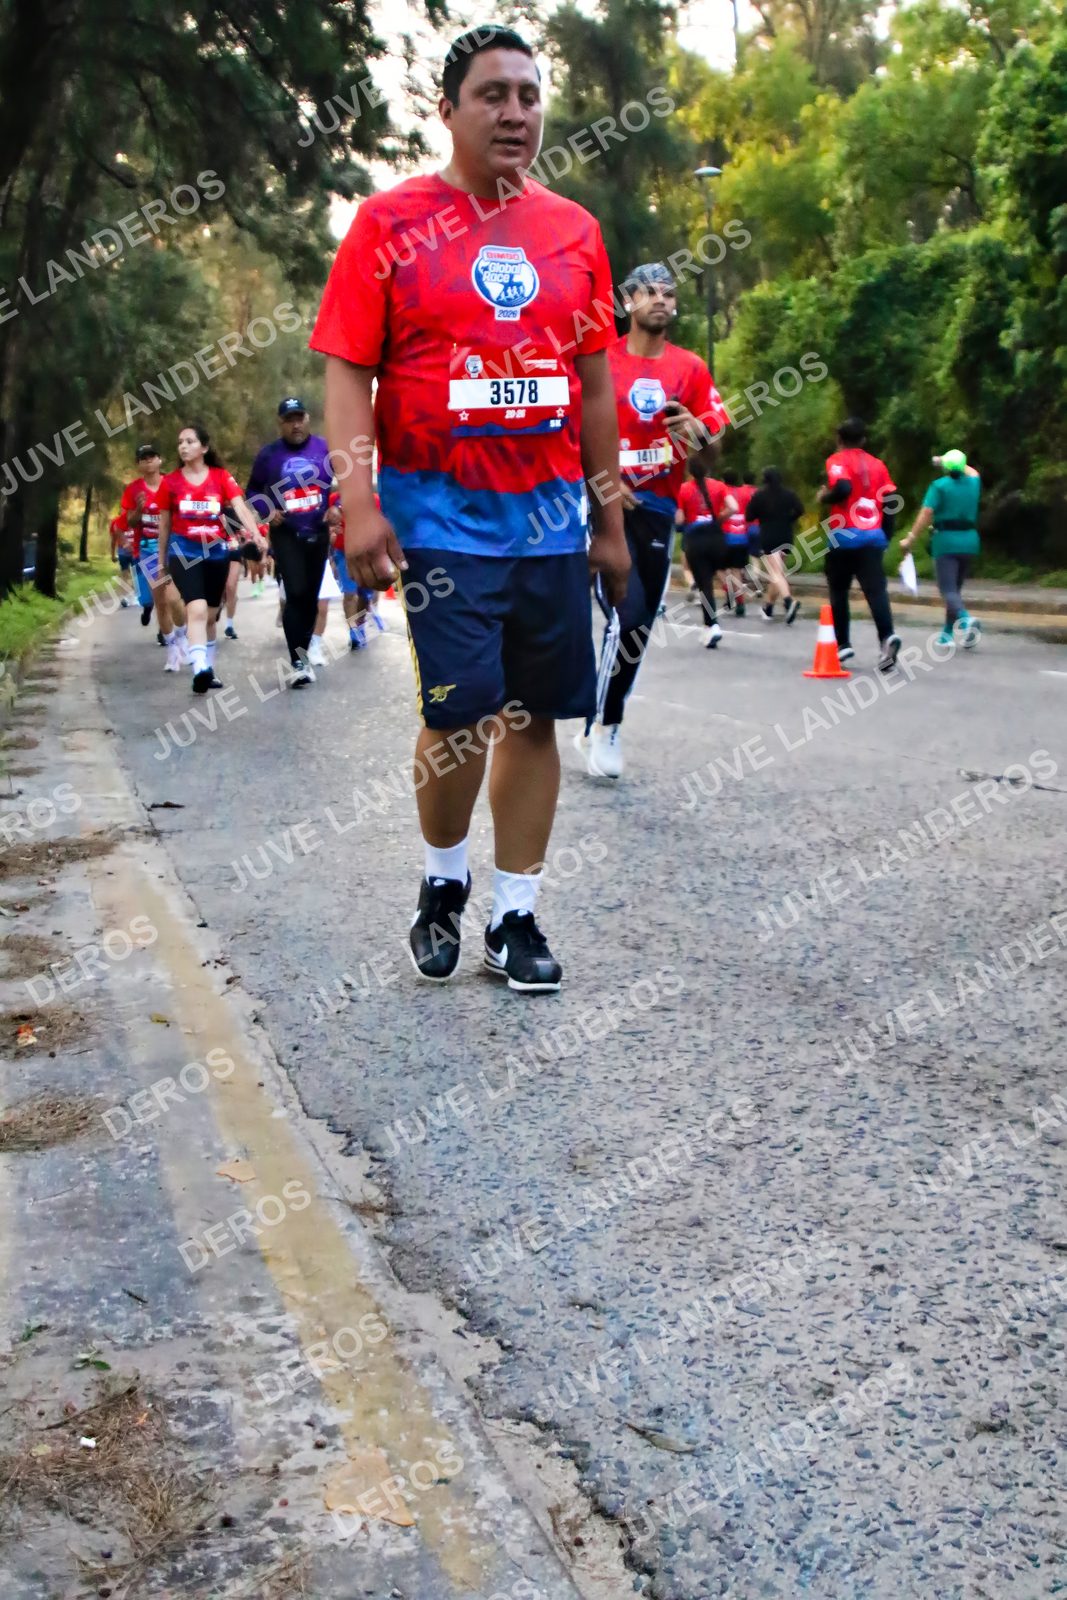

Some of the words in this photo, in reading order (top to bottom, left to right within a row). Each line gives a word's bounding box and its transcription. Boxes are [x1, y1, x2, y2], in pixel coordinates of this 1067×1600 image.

[489, 261, 521, 274] Global
[482, 270, 510, 283] Race
[497, 309, 518, 318] 2026
[490, 380, 538, 405] 3578
